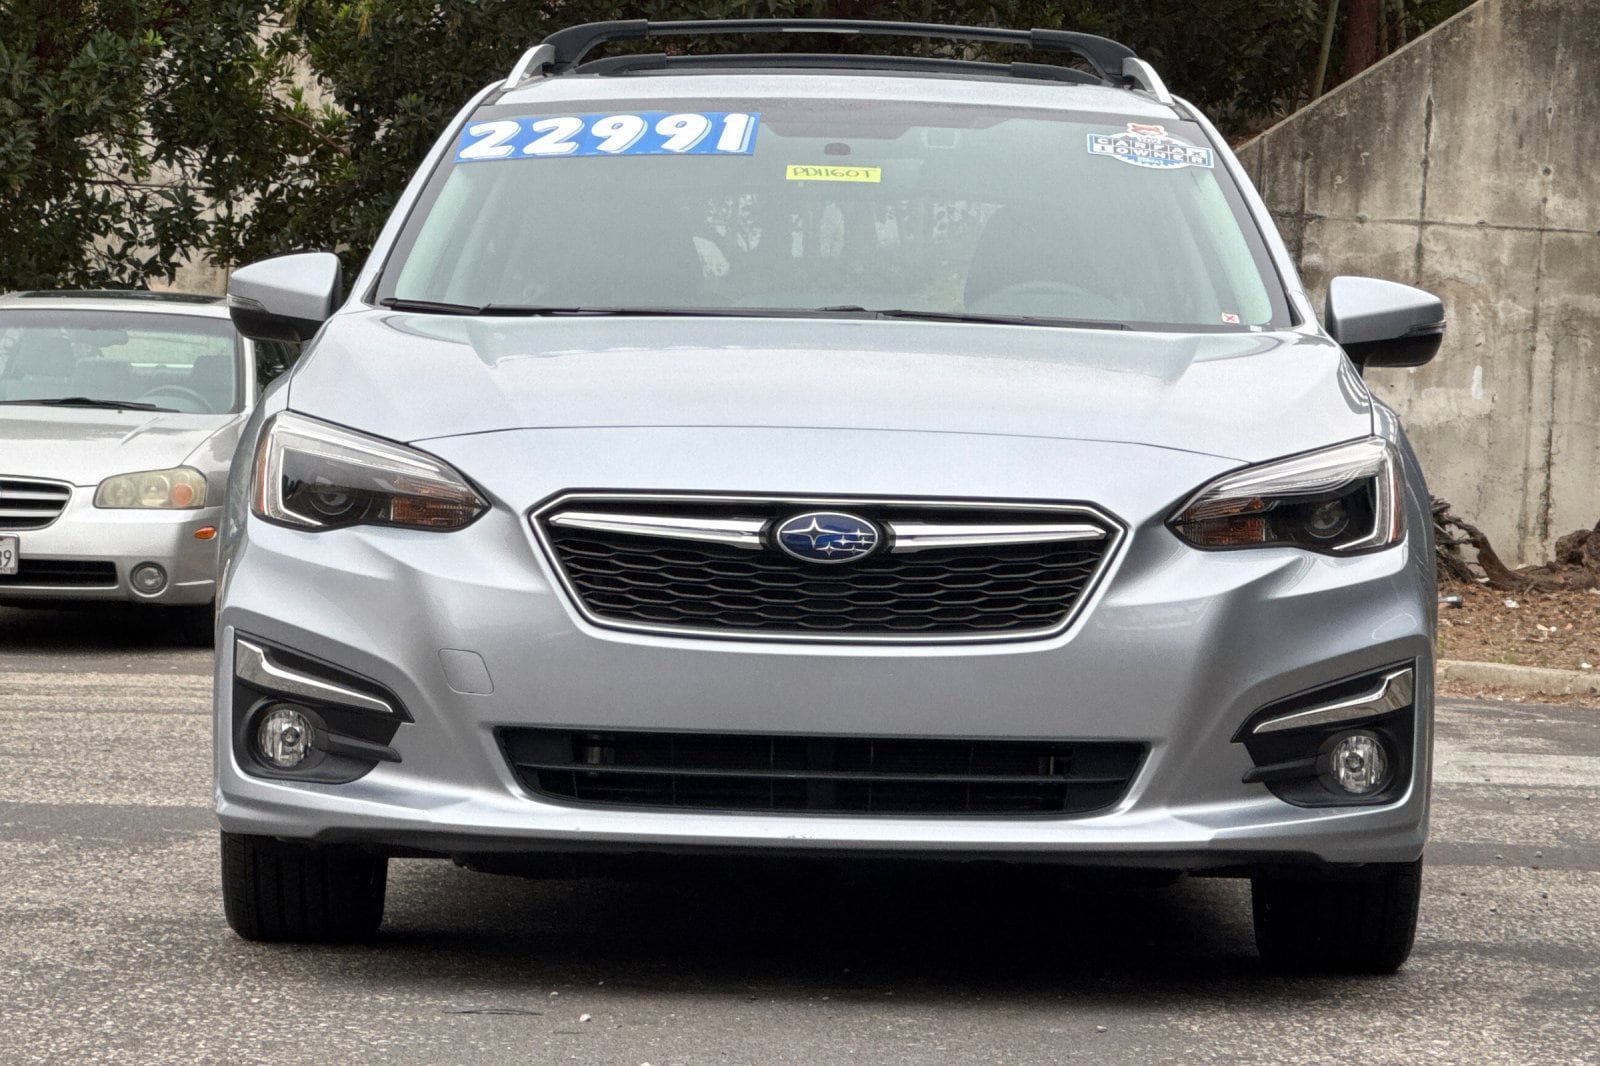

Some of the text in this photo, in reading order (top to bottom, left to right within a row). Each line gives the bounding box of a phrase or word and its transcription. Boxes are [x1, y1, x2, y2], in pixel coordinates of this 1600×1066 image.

[459, 113, 755, 159] 22991
[1096, 138, 1203, 156] CARFAX
[1115, 147, 1203, 163] OWNER
